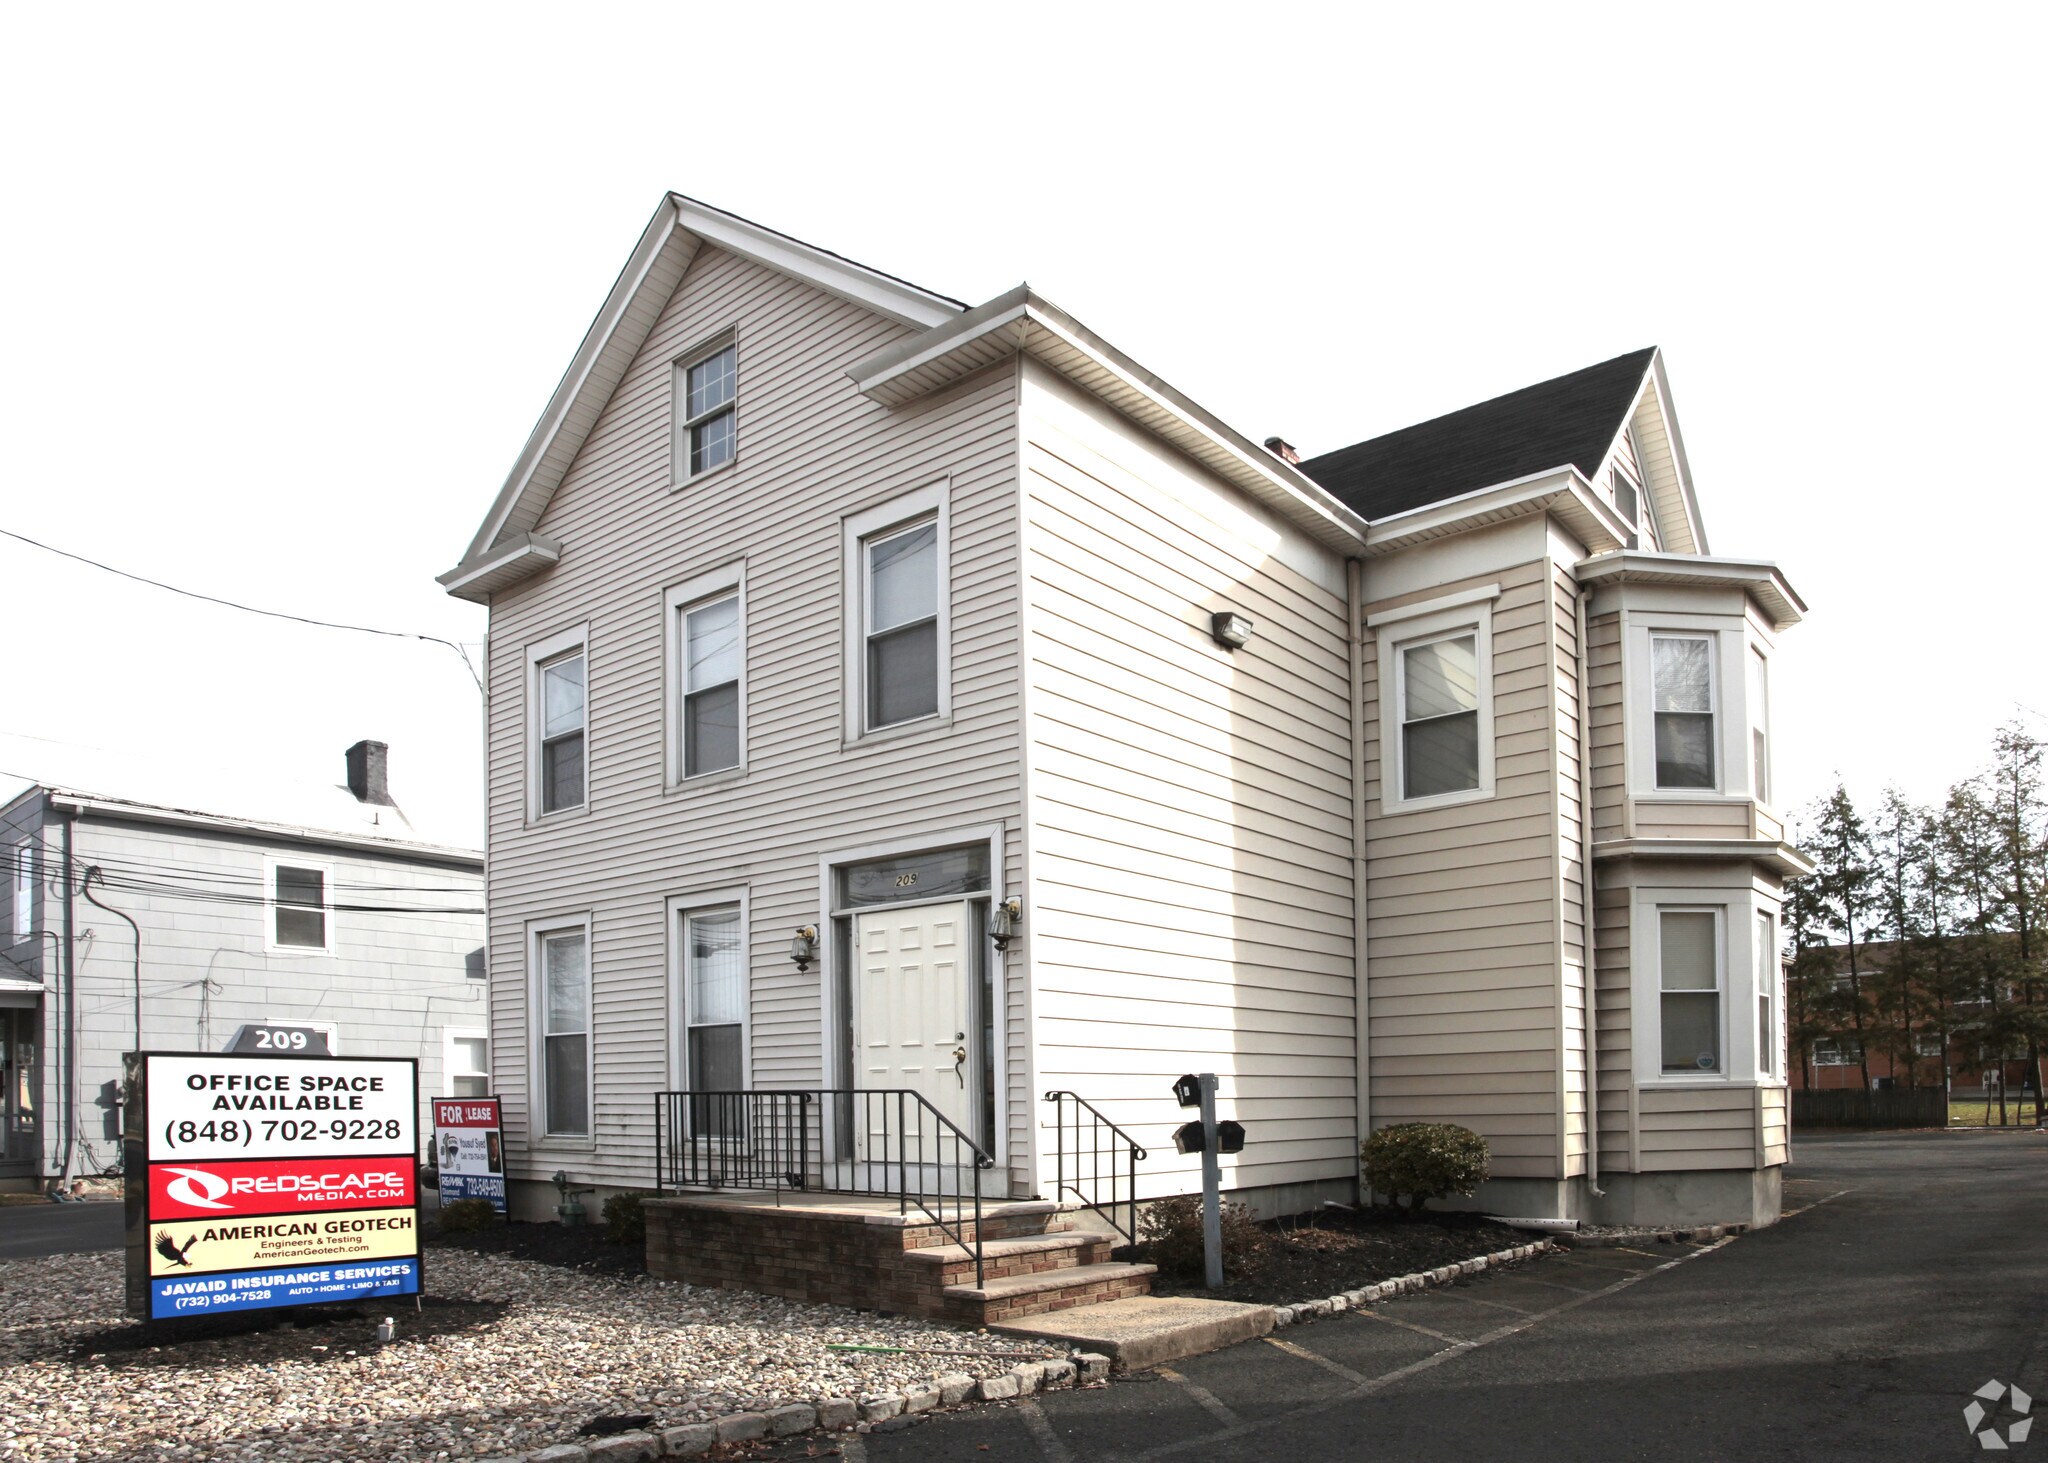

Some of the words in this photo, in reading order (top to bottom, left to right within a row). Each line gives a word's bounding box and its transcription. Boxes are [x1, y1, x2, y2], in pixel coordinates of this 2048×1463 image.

[895, 873, 917, 887] 209
[255, 1030, 307, 1049] 209
[186, 1074, 290, 1092] OFFICE
[300, 1076, 384, 1092] SPACE
[212, 1095, 364, 1111] AVAILABLE
[440, 1105, 463, 1124] FOR
[467, 1107, 492, 1121] LEASE
[165, 1119, 253, 1149] (848)
[261, 1119, 401, 1142] 702-9228
[231, 1171, 404, 1194] REDSCAPE
[297, 1189, 405, 1202] MEDIA.COM
[202, 1222, 318, 1242] AMERICAN
[324, 1217, 412, 1234] GEOTECH
[261, 1238, 313, 1250] Engineers
[317, 1237, 324, 1245] &
[326, 1235, 362, 1245] Testing
[253, 1245, 369, 1260] AmericanGeotech.com
[161, 1279, 227, 1296] JAVAID
[231, 1271, 331, 1289] INSURANCE
[334, 1264, 411, 1281] SERVICES
[289, 1286, 313, 1295] AUTO
[320, 1283, 346, 1292] HOME
[352, 1280, 373, 1289] LIMO
[375, 1280, 381, 1288] &
[382, 1278, 400, 1287] TAXI
[175, 1295, 210, 1310] (732)
[213, 1289, 272, 1305] 904-7528
